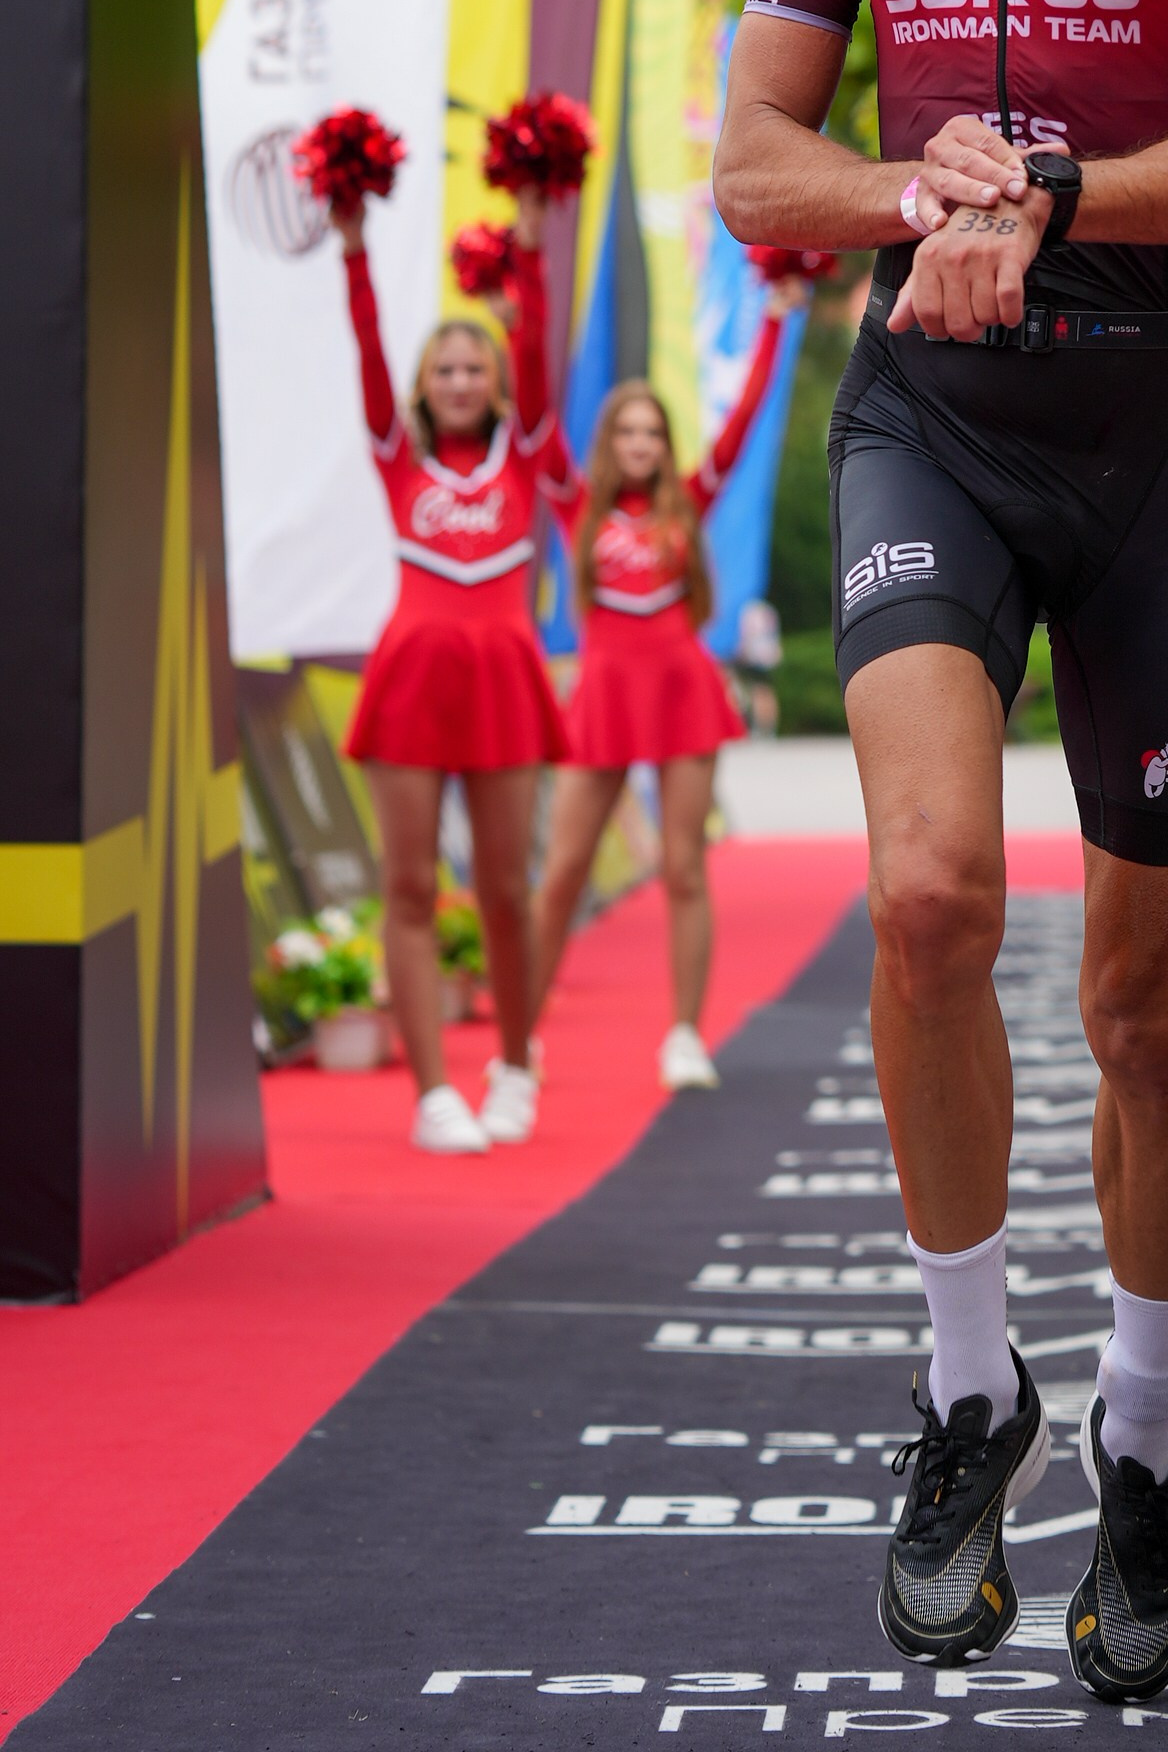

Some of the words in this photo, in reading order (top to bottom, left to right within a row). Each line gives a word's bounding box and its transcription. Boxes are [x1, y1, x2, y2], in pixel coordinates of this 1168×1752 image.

[892, 15, 1030, 45] IRONMAN
[1044, 16, 1141, 44] TEAM
[958, 112, 1070, 148] ES
[958, 212, 1018, 235] 358
[1108, 325, 1141, 333] RUSSIA
[846, 586, 879, 611] SCIENCE
[882, 580, 893, 589] IN
[899, 574, 936, 583] SPORT
